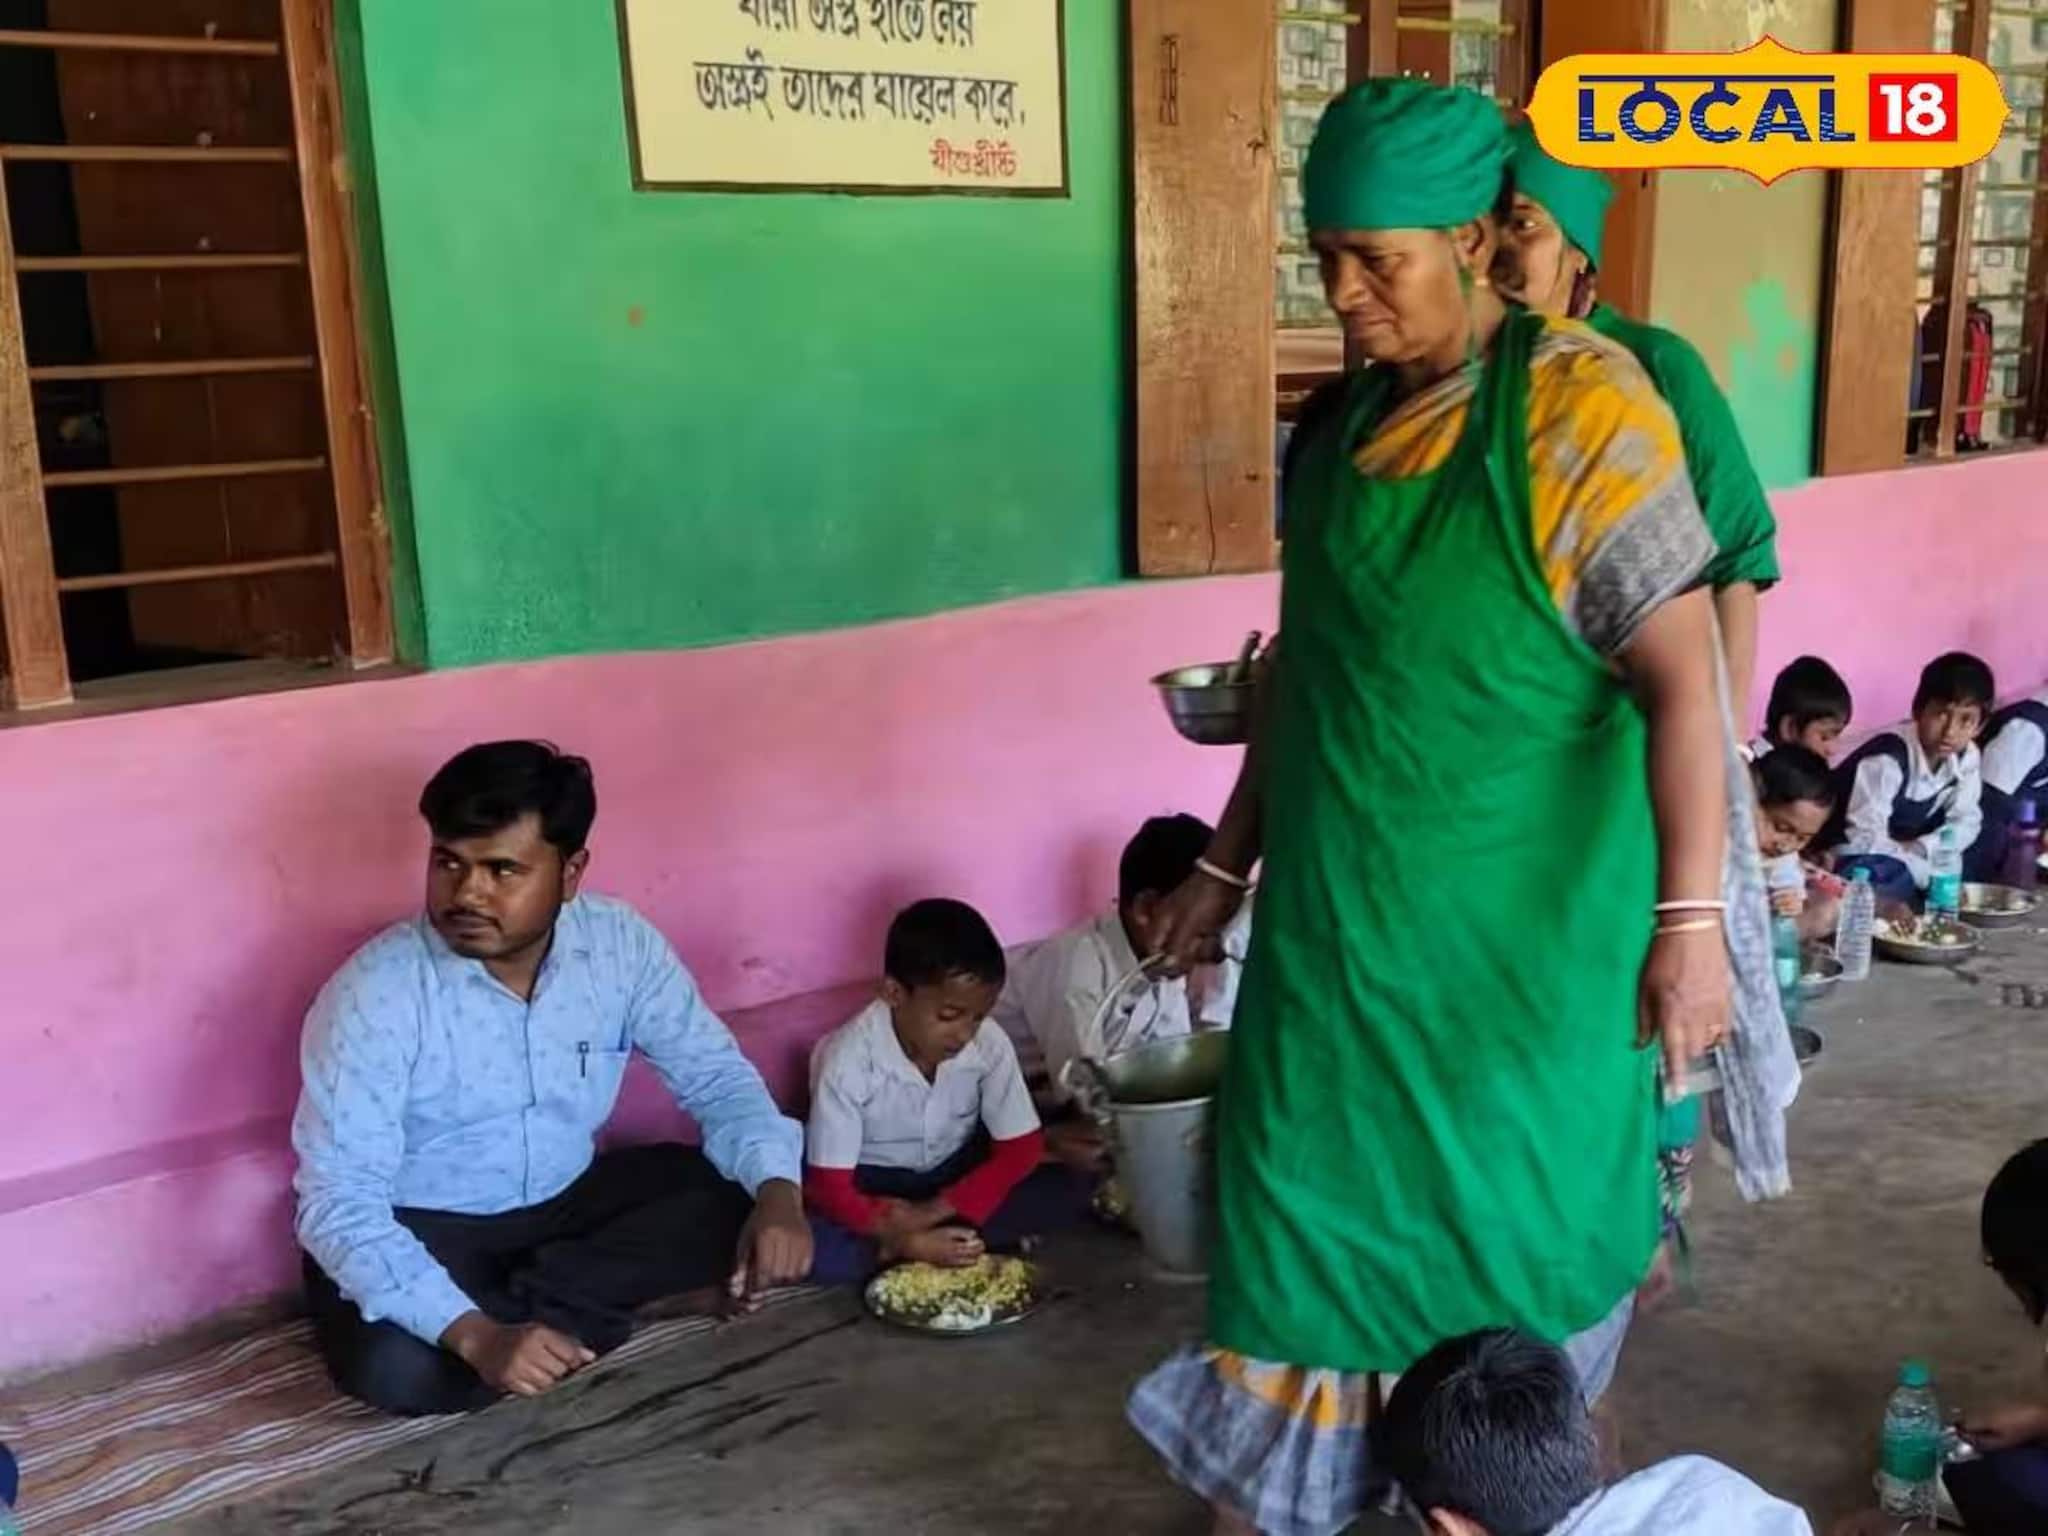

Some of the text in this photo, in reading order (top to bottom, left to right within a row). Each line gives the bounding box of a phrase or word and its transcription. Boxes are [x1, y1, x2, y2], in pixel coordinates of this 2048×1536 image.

[808, 0, 860, 39] অস্ত্র
[868, 0, 925, 43] হাতে
[930, 0, 977, 47] নেয়
[693, 45, 774, 121] অস্ত্রই
[780, 66, 867, 120] তাদের
[871, 72, 958, 125] ঘায়েল
